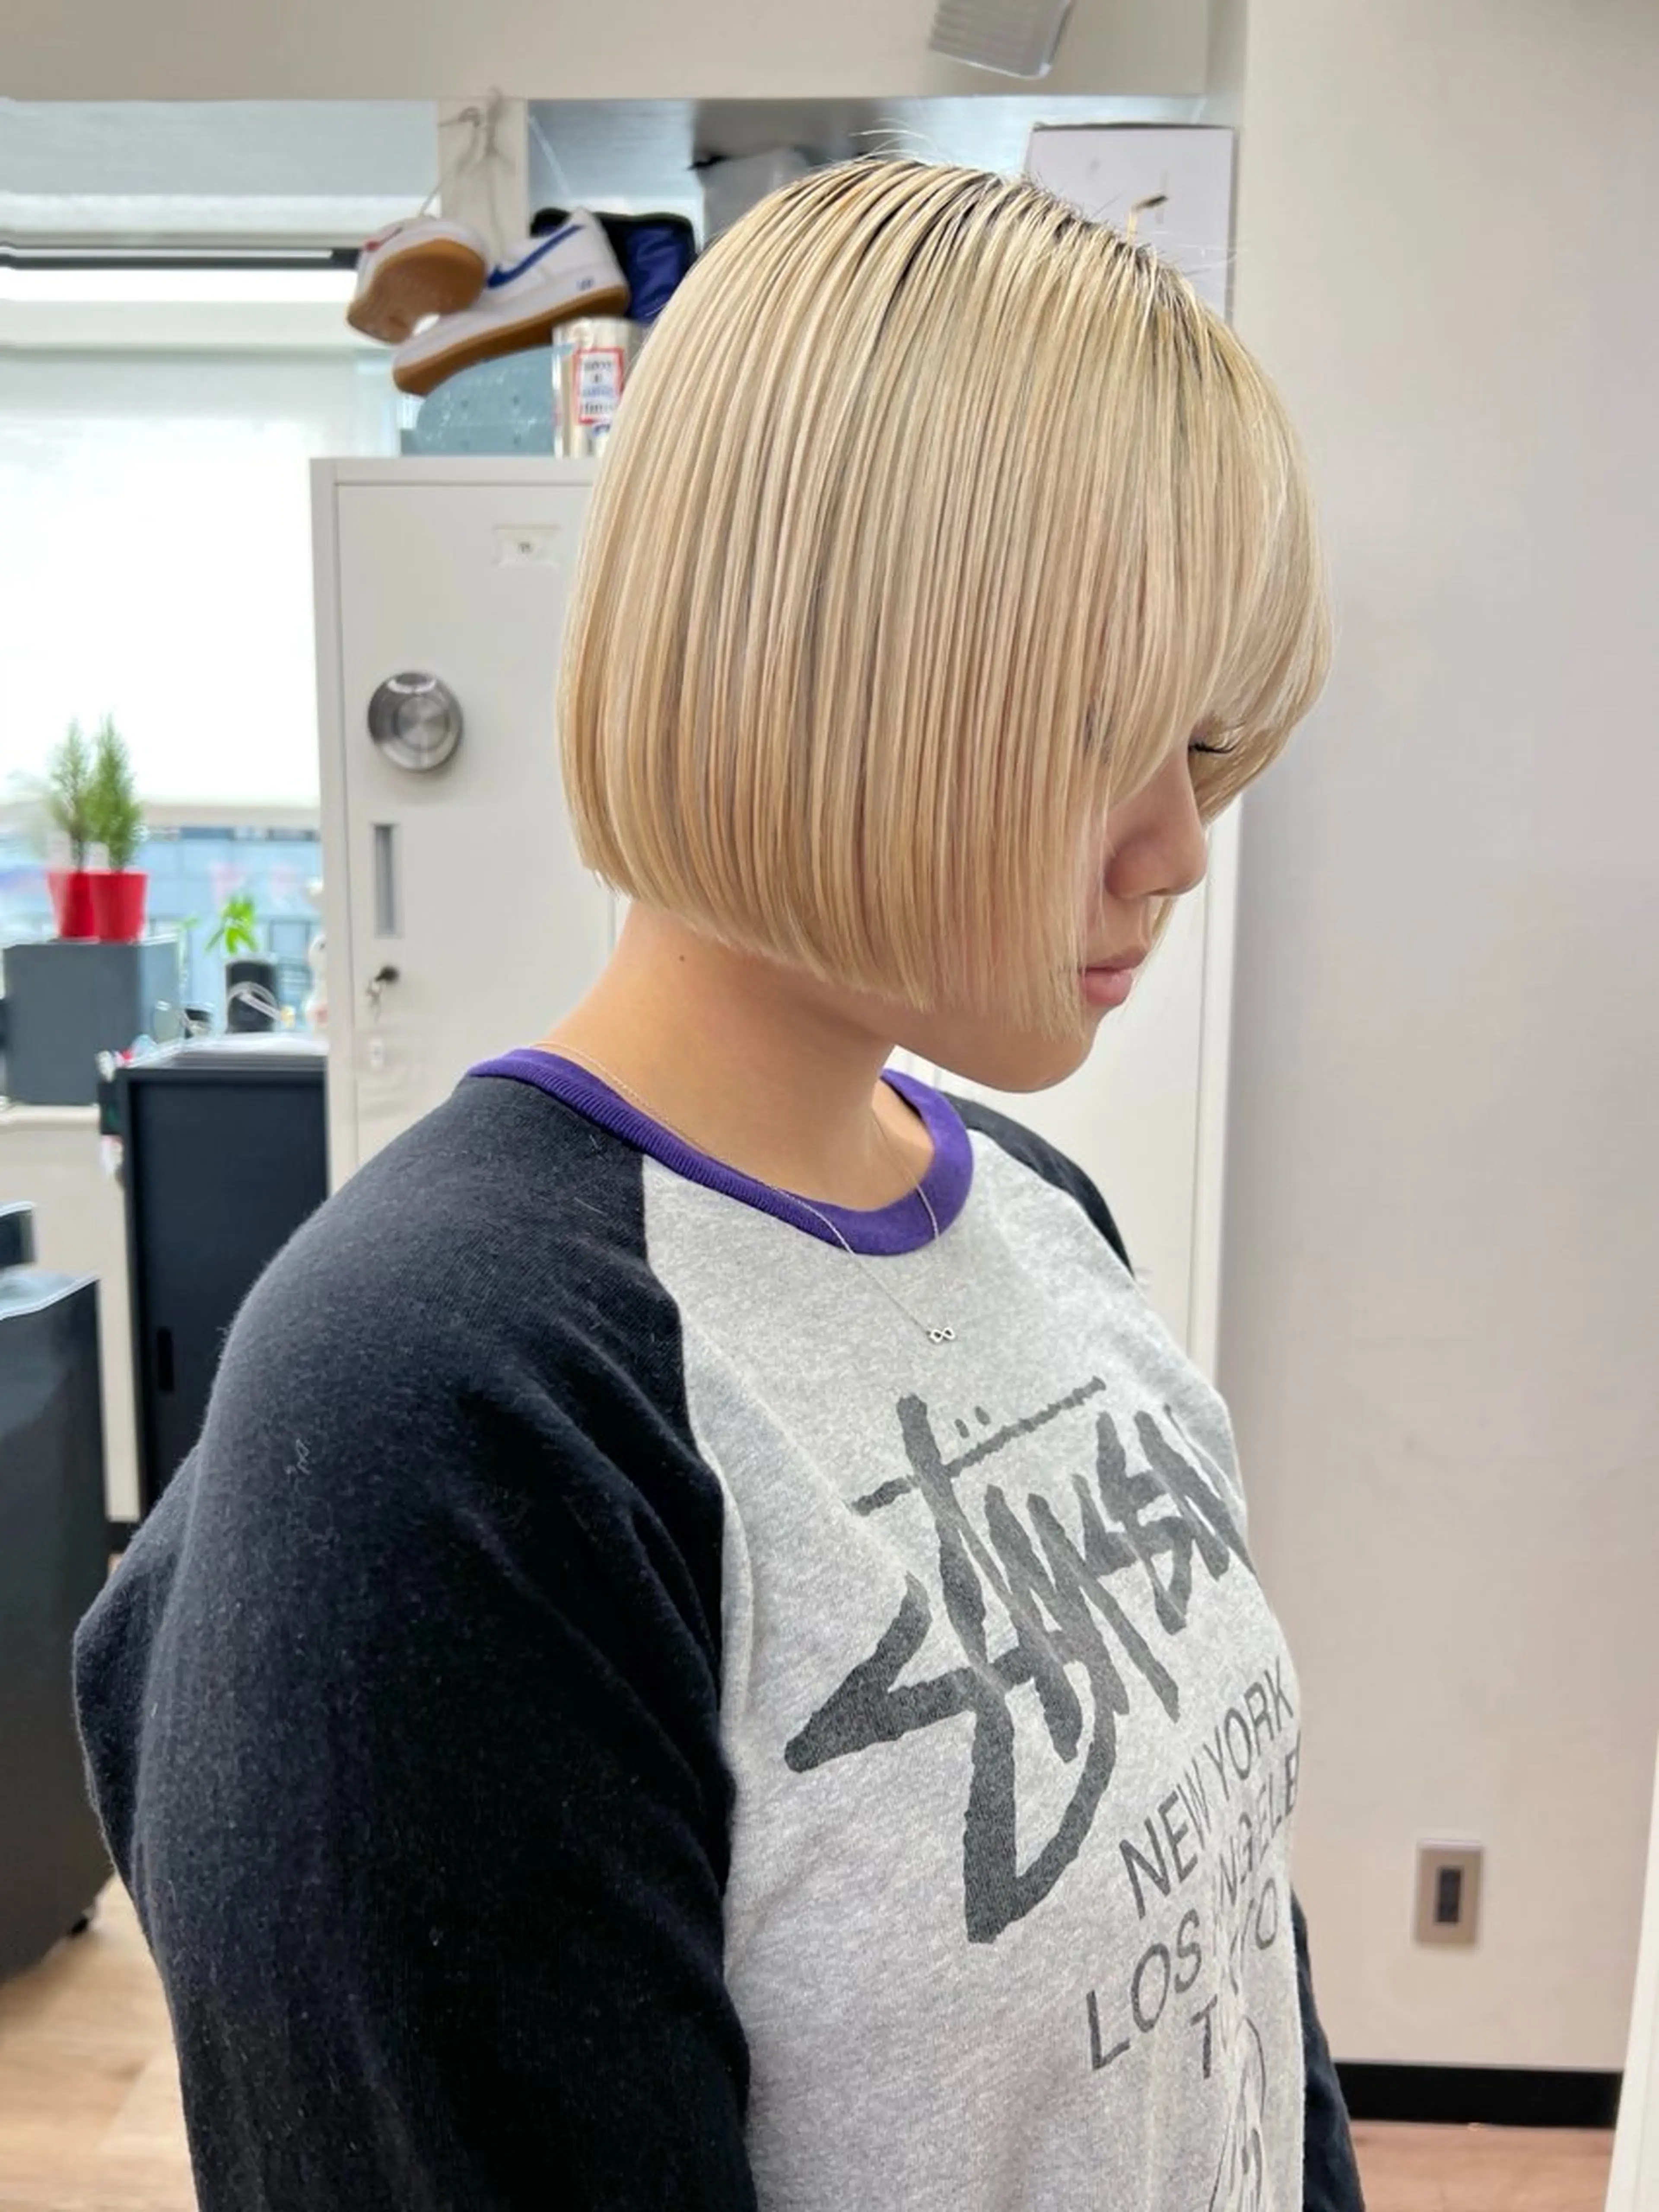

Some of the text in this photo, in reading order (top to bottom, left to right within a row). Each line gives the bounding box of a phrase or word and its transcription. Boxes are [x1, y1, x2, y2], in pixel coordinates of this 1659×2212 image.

[1119, 1655, 1294, 1920] NEW YORK
[1086, 1908, 1202, 2070] LOS
